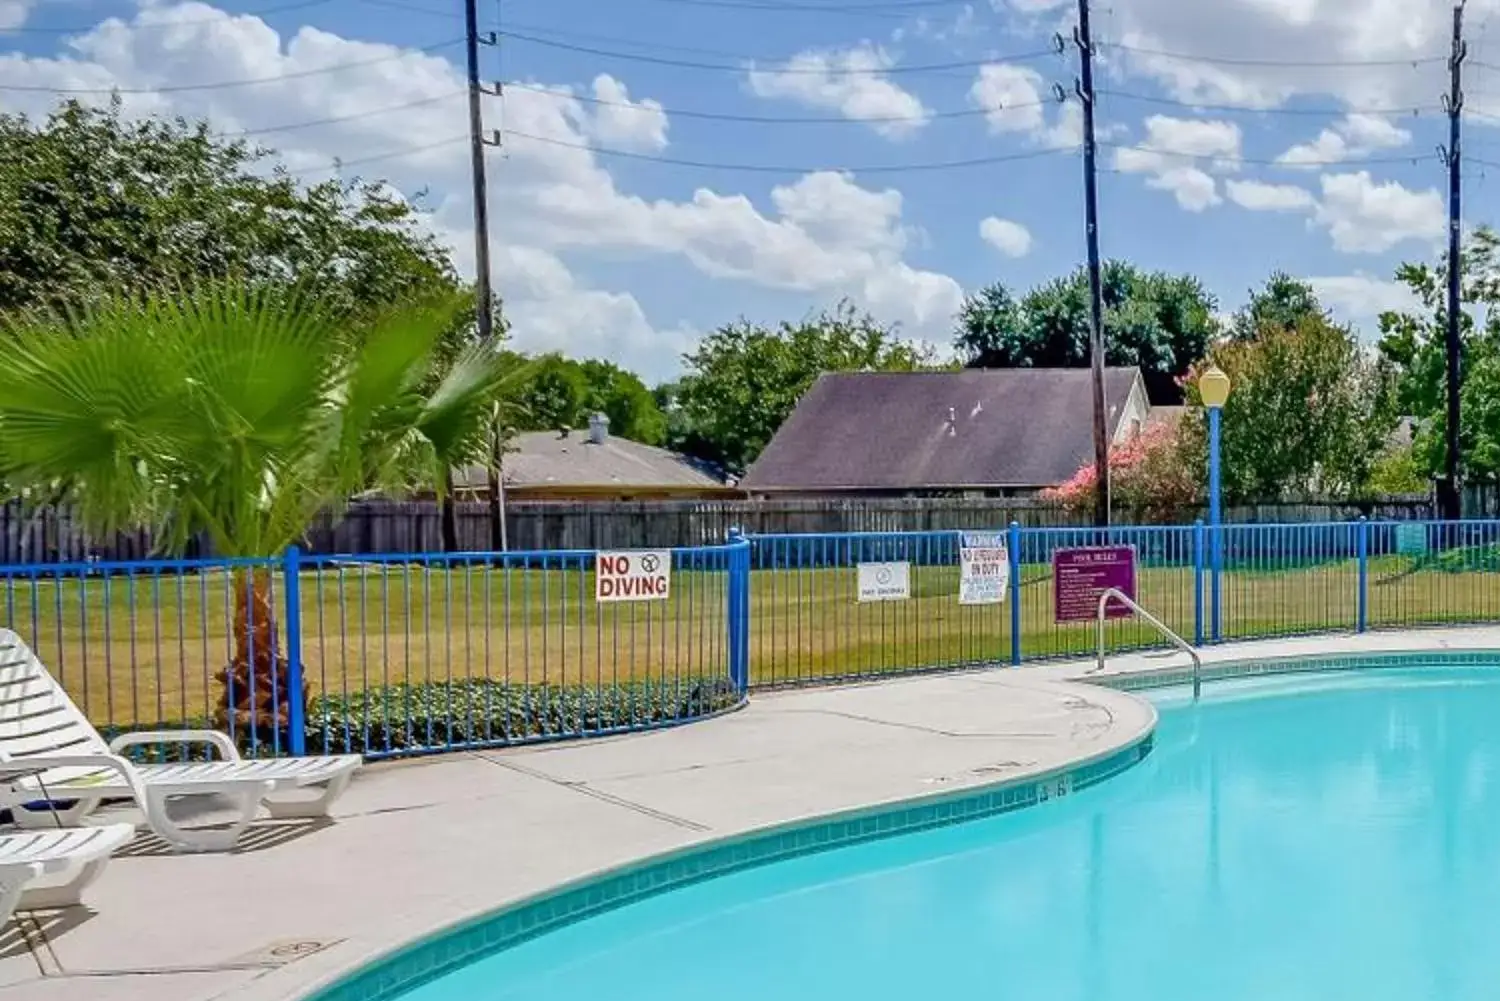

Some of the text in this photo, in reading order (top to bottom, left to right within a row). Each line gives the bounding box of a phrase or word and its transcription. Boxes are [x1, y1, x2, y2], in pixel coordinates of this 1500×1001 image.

[962, 549, 972, 562] NO
[600, 556, 630, 575] NO
[971, 563, 999, 576] ON DUTY
[600, 575, 667, 597] DIVING
